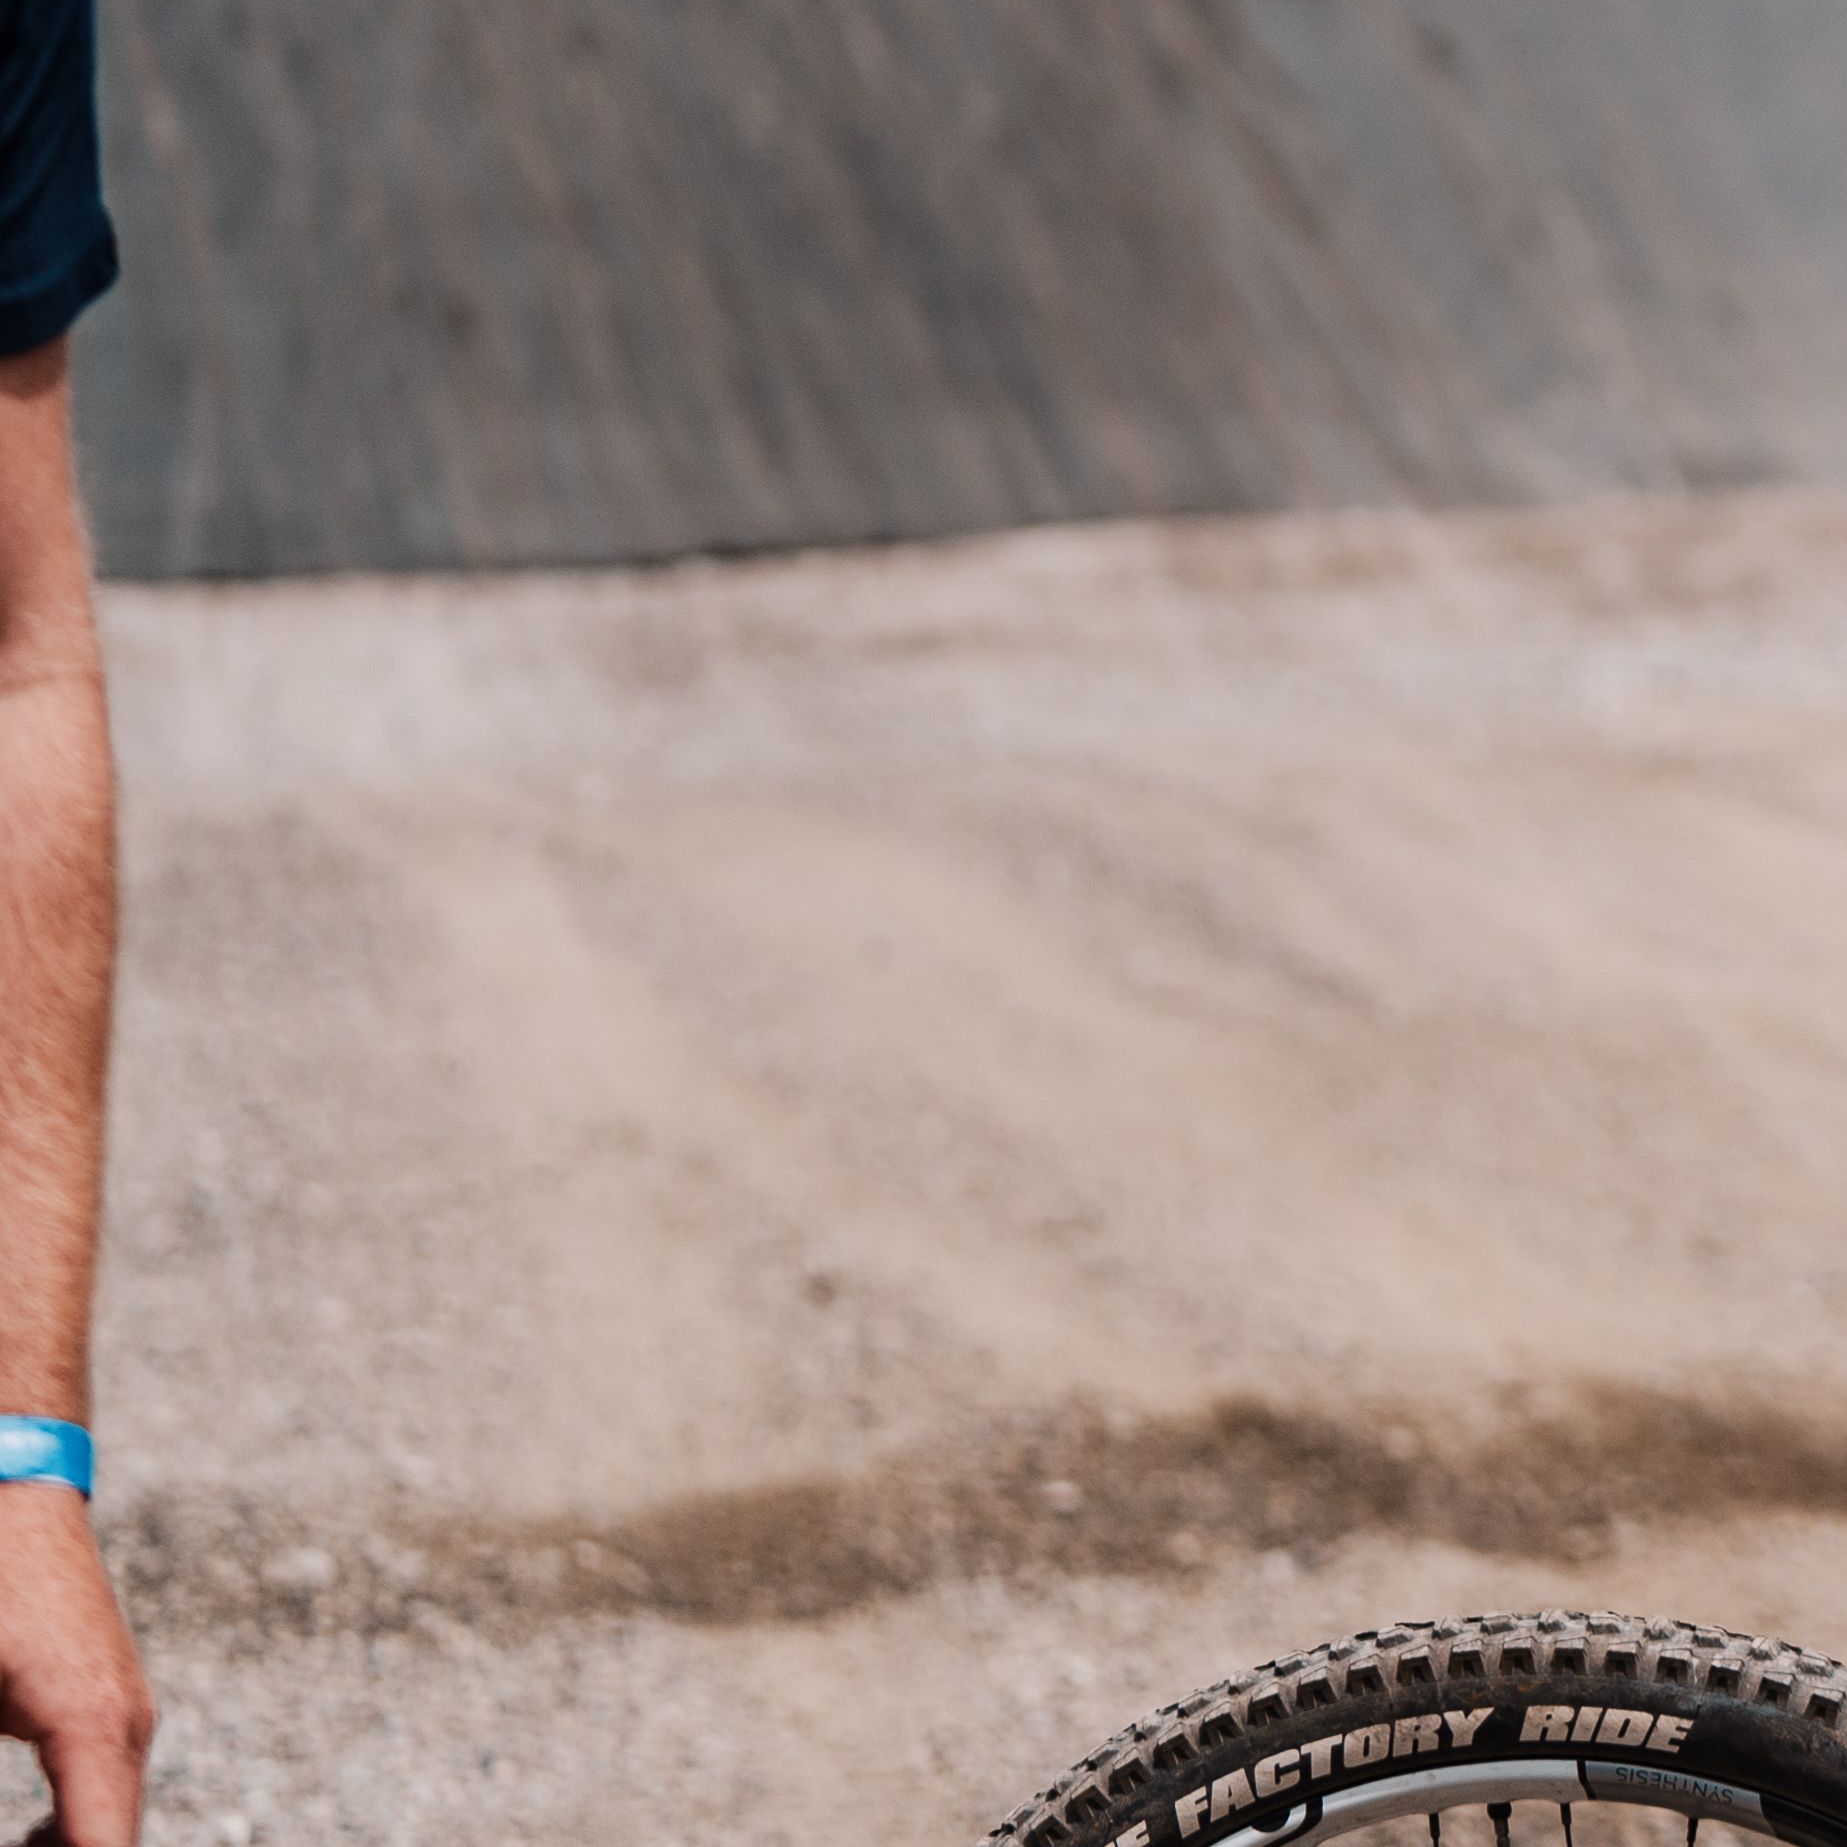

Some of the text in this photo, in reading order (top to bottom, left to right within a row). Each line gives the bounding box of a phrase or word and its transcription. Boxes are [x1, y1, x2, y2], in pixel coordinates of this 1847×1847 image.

[1174, 1704, 1695, 1839] FACTORY RIDE
[1615, 1766, 1735, 1804] SYNTHESIS
